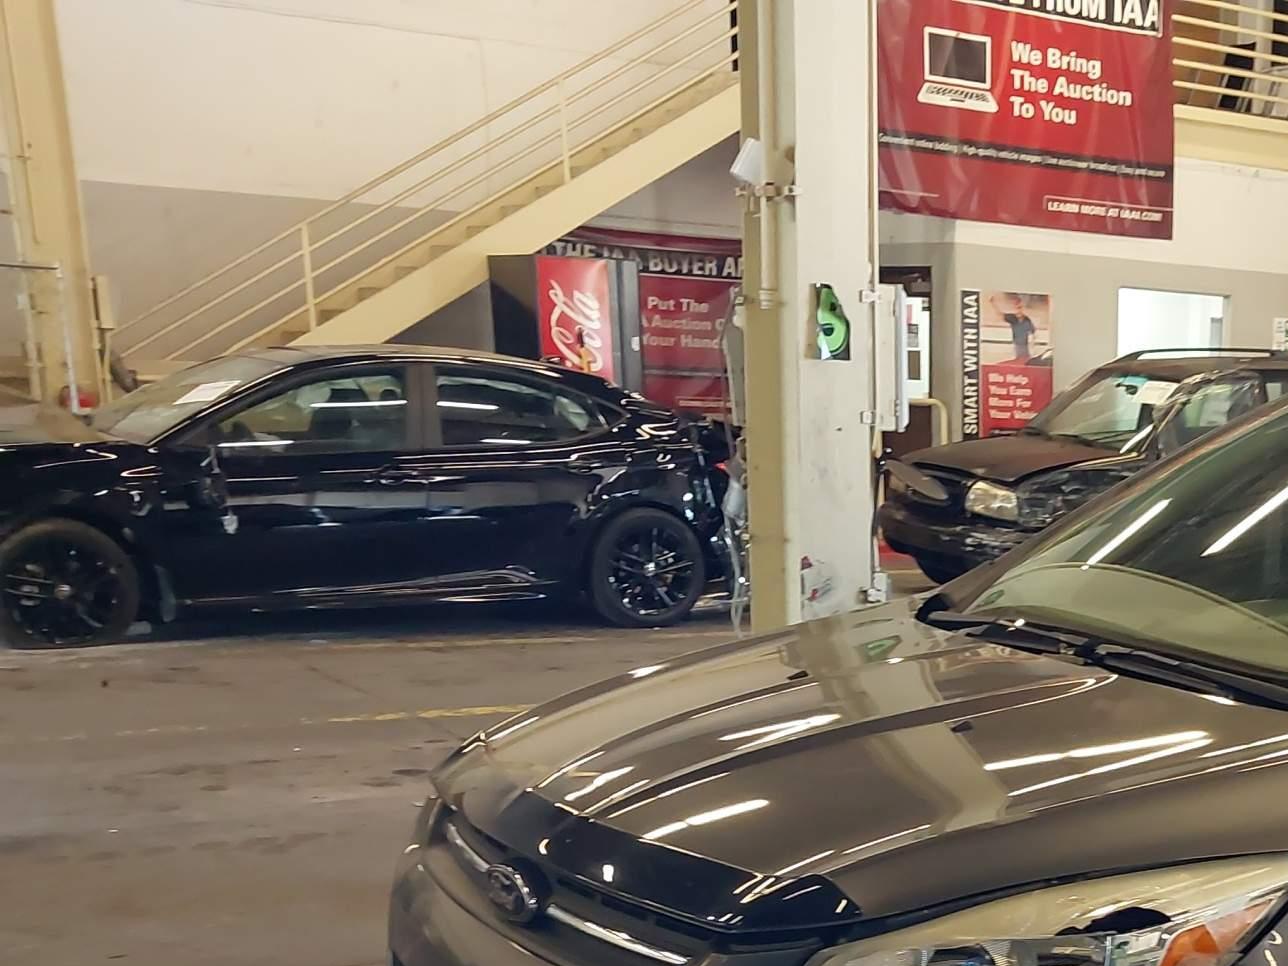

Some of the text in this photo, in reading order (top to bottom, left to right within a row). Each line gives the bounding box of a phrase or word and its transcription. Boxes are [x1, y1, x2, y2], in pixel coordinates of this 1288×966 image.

[1113, 0, 1159, 28] IAA
[1010, 40, 1102, 80] We Bring
[1010, 68, 1133, 106] The Auction
[1008, 95, 1078, 125] To You
[650, 255, 718, 276] BUYER
[647, 296, 710, 313] Put The
[651, 314, 713, 331] Auction
[963, 294, 978, 434] SMART WITH IAA
